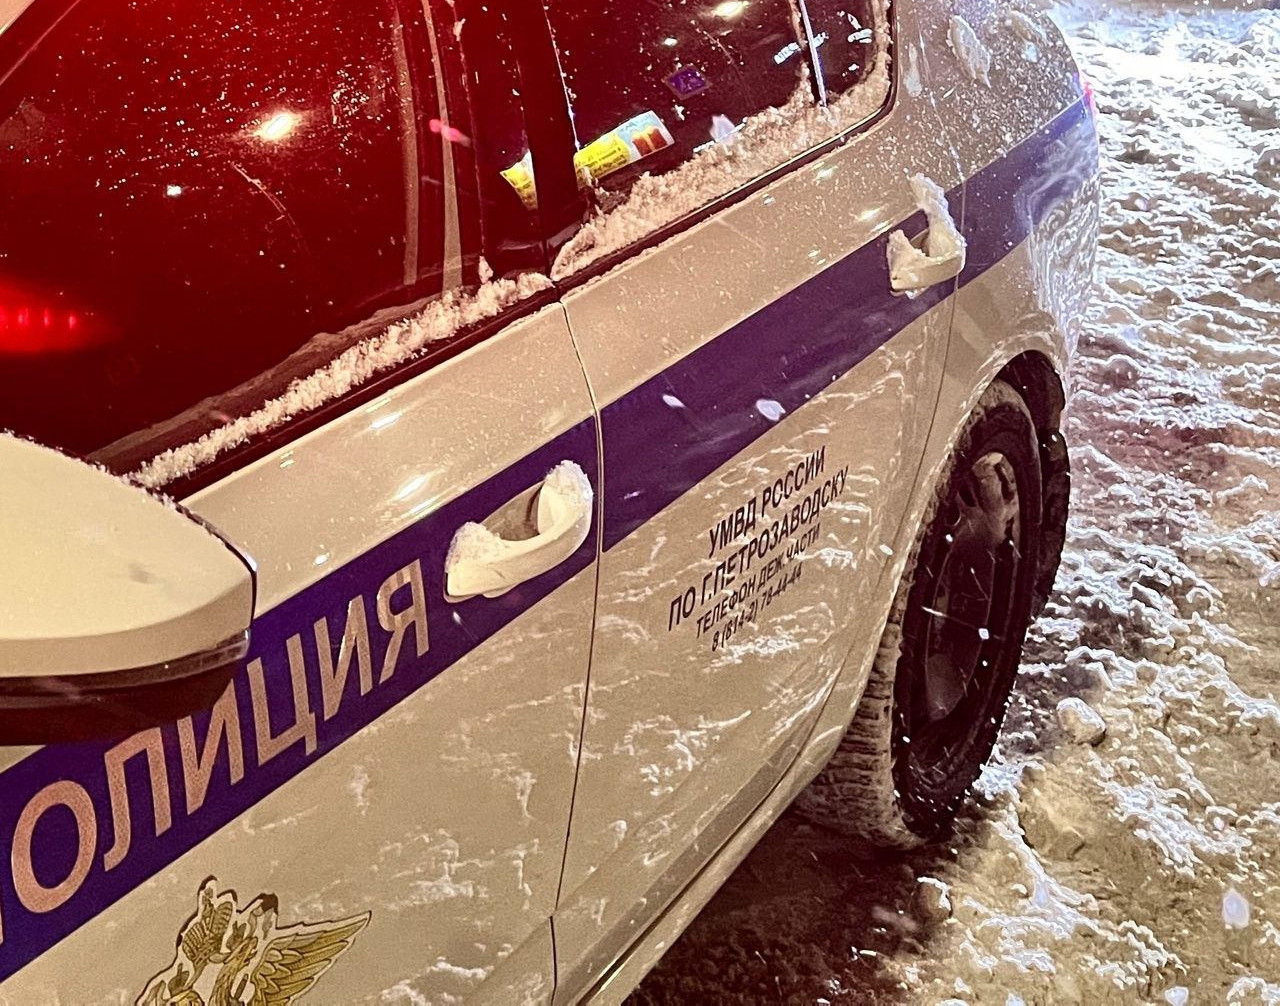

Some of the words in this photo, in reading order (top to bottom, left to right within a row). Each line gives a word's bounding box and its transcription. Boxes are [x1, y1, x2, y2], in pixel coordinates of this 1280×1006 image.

[668, 586, 696, 632] ПО
[701, 465, 848, 606] Г.ПЕТРОЗАВОДСКУ
[708, 497, 756, 559] УМВД
[761, 445, 826, 518] РОССИИ
[696, 574, 756, 639] ТЕЛЕФОН
[757, 553, 785, 593] ДЕЖ.
[786, 522, 821, 562] ЧАСТИ
[711, 630, 720, 652] 8
